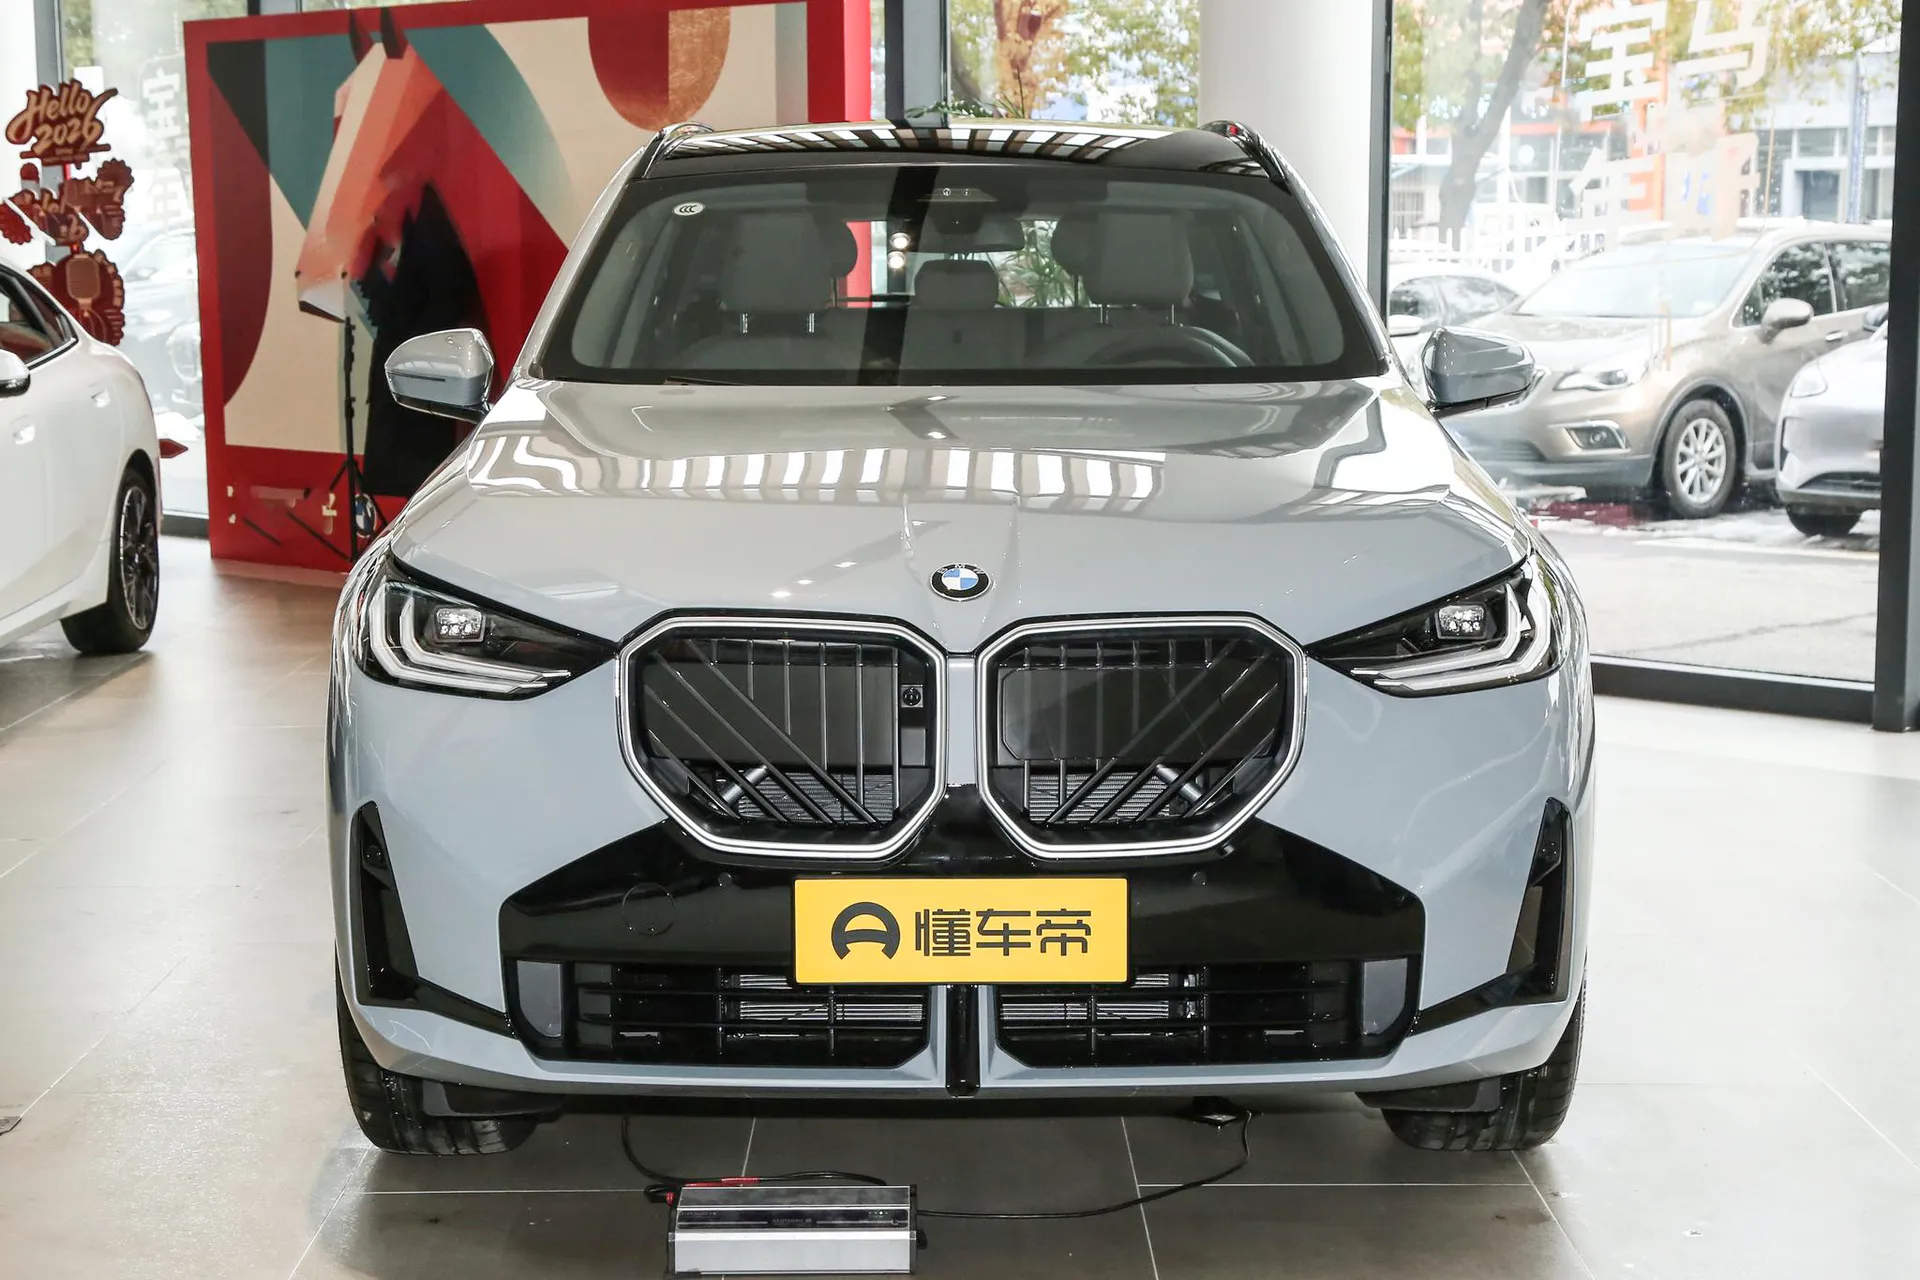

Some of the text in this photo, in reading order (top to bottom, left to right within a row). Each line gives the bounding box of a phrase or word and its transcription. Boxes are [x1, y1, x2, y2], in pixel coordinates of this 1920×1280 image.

[7, 79, 91, 142] Hello
[33, 89, 117, 156] 2026
[914, 908, 1092, 957] 懂车帝
